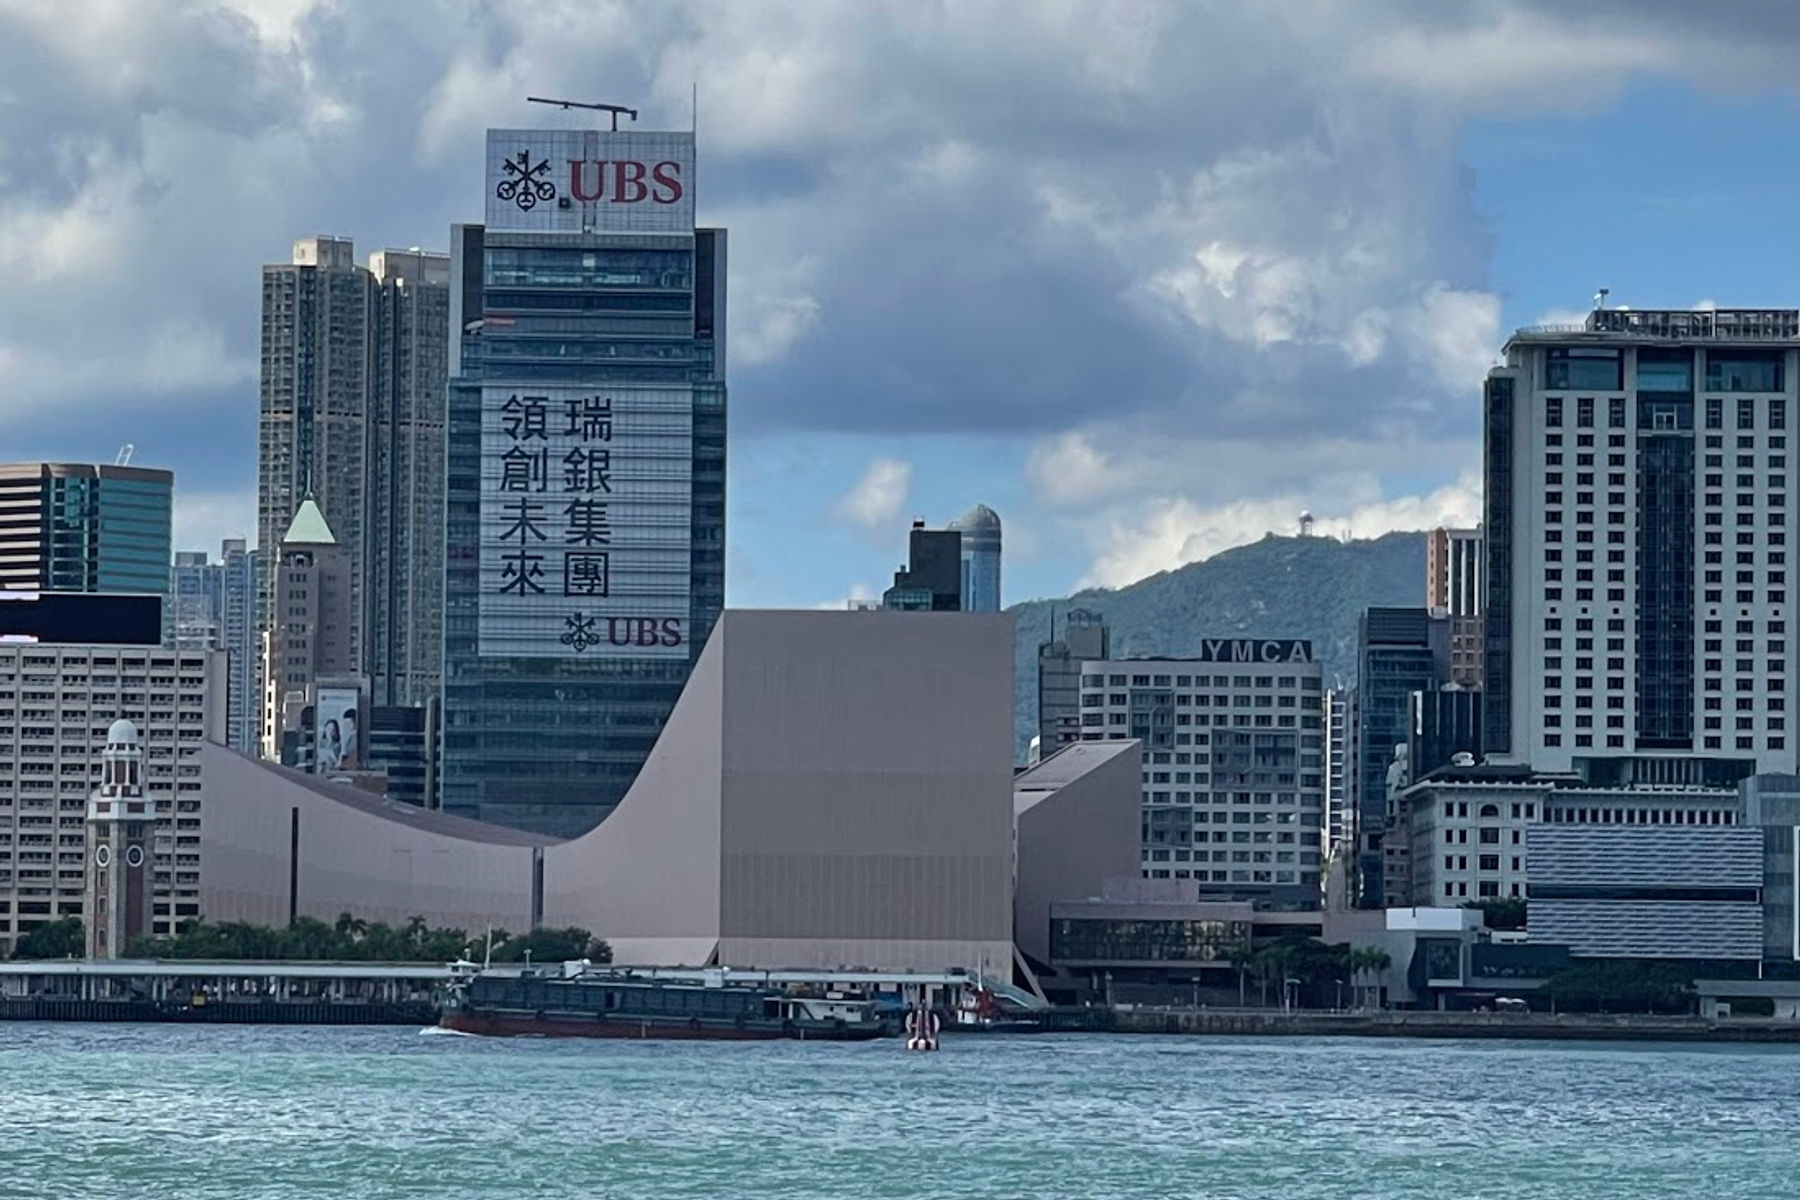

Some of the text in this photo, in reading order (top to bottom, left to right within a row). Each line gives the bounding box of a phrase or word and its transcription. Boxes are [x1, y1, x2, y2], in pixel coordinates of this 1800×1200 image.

[567, 160, 683, 205] UBS
[499, 394, 549, 597] 領創未來
[562, 396, 612, 598] 瑞銀集團
[606, 616, 682, 647] UBS
[1206, 640, 1309, 663] YMCA
